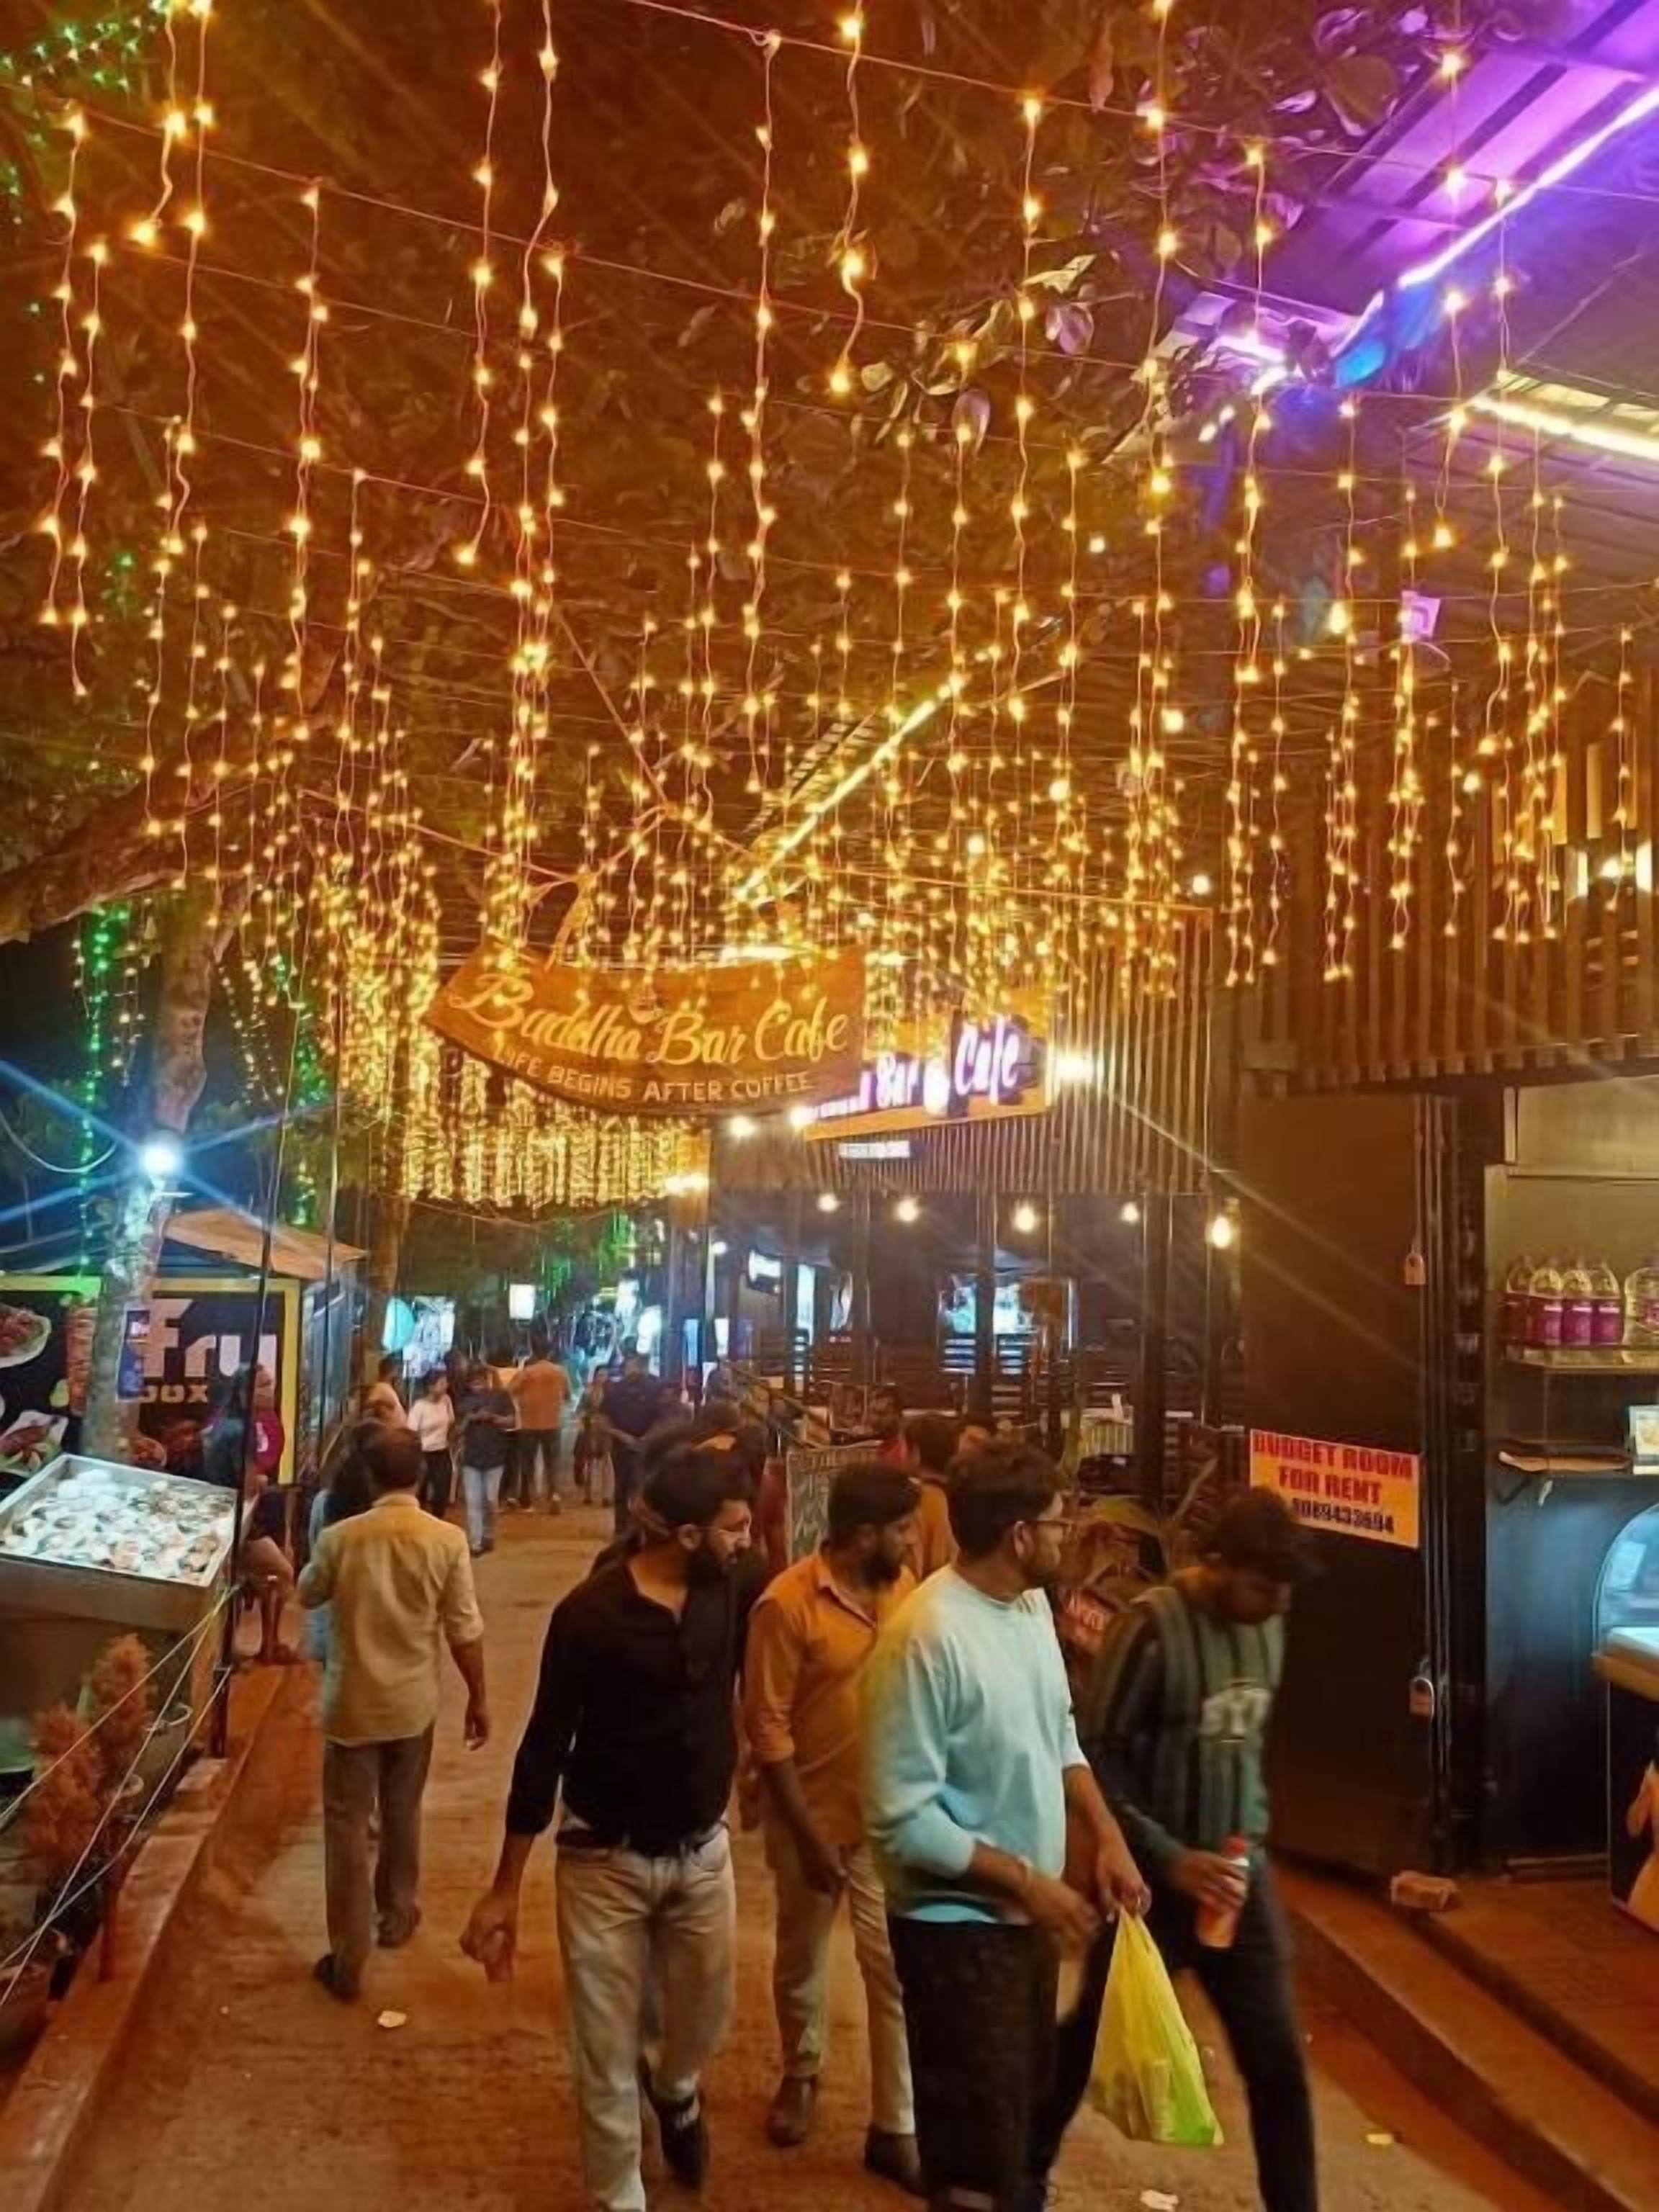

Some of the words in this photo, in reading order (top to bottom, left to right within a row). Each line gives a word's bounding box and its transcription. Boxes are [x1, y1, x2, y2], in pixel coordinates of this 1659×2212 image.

[646, 1010, 747, 1065] Bar
[755, 996, 849, 1061] Cafe
[547, 1066, 632, 1100] BEGINS
[644, 1079, 723, 1102] AFTER
[730, 1071, 815, 1099] COFFEE
[1342, 1449, 1413, 1480] ROOM
[1280, 1466, 1319, 1493] FOR
[1325, 1474, 1382, 1504] RENT
